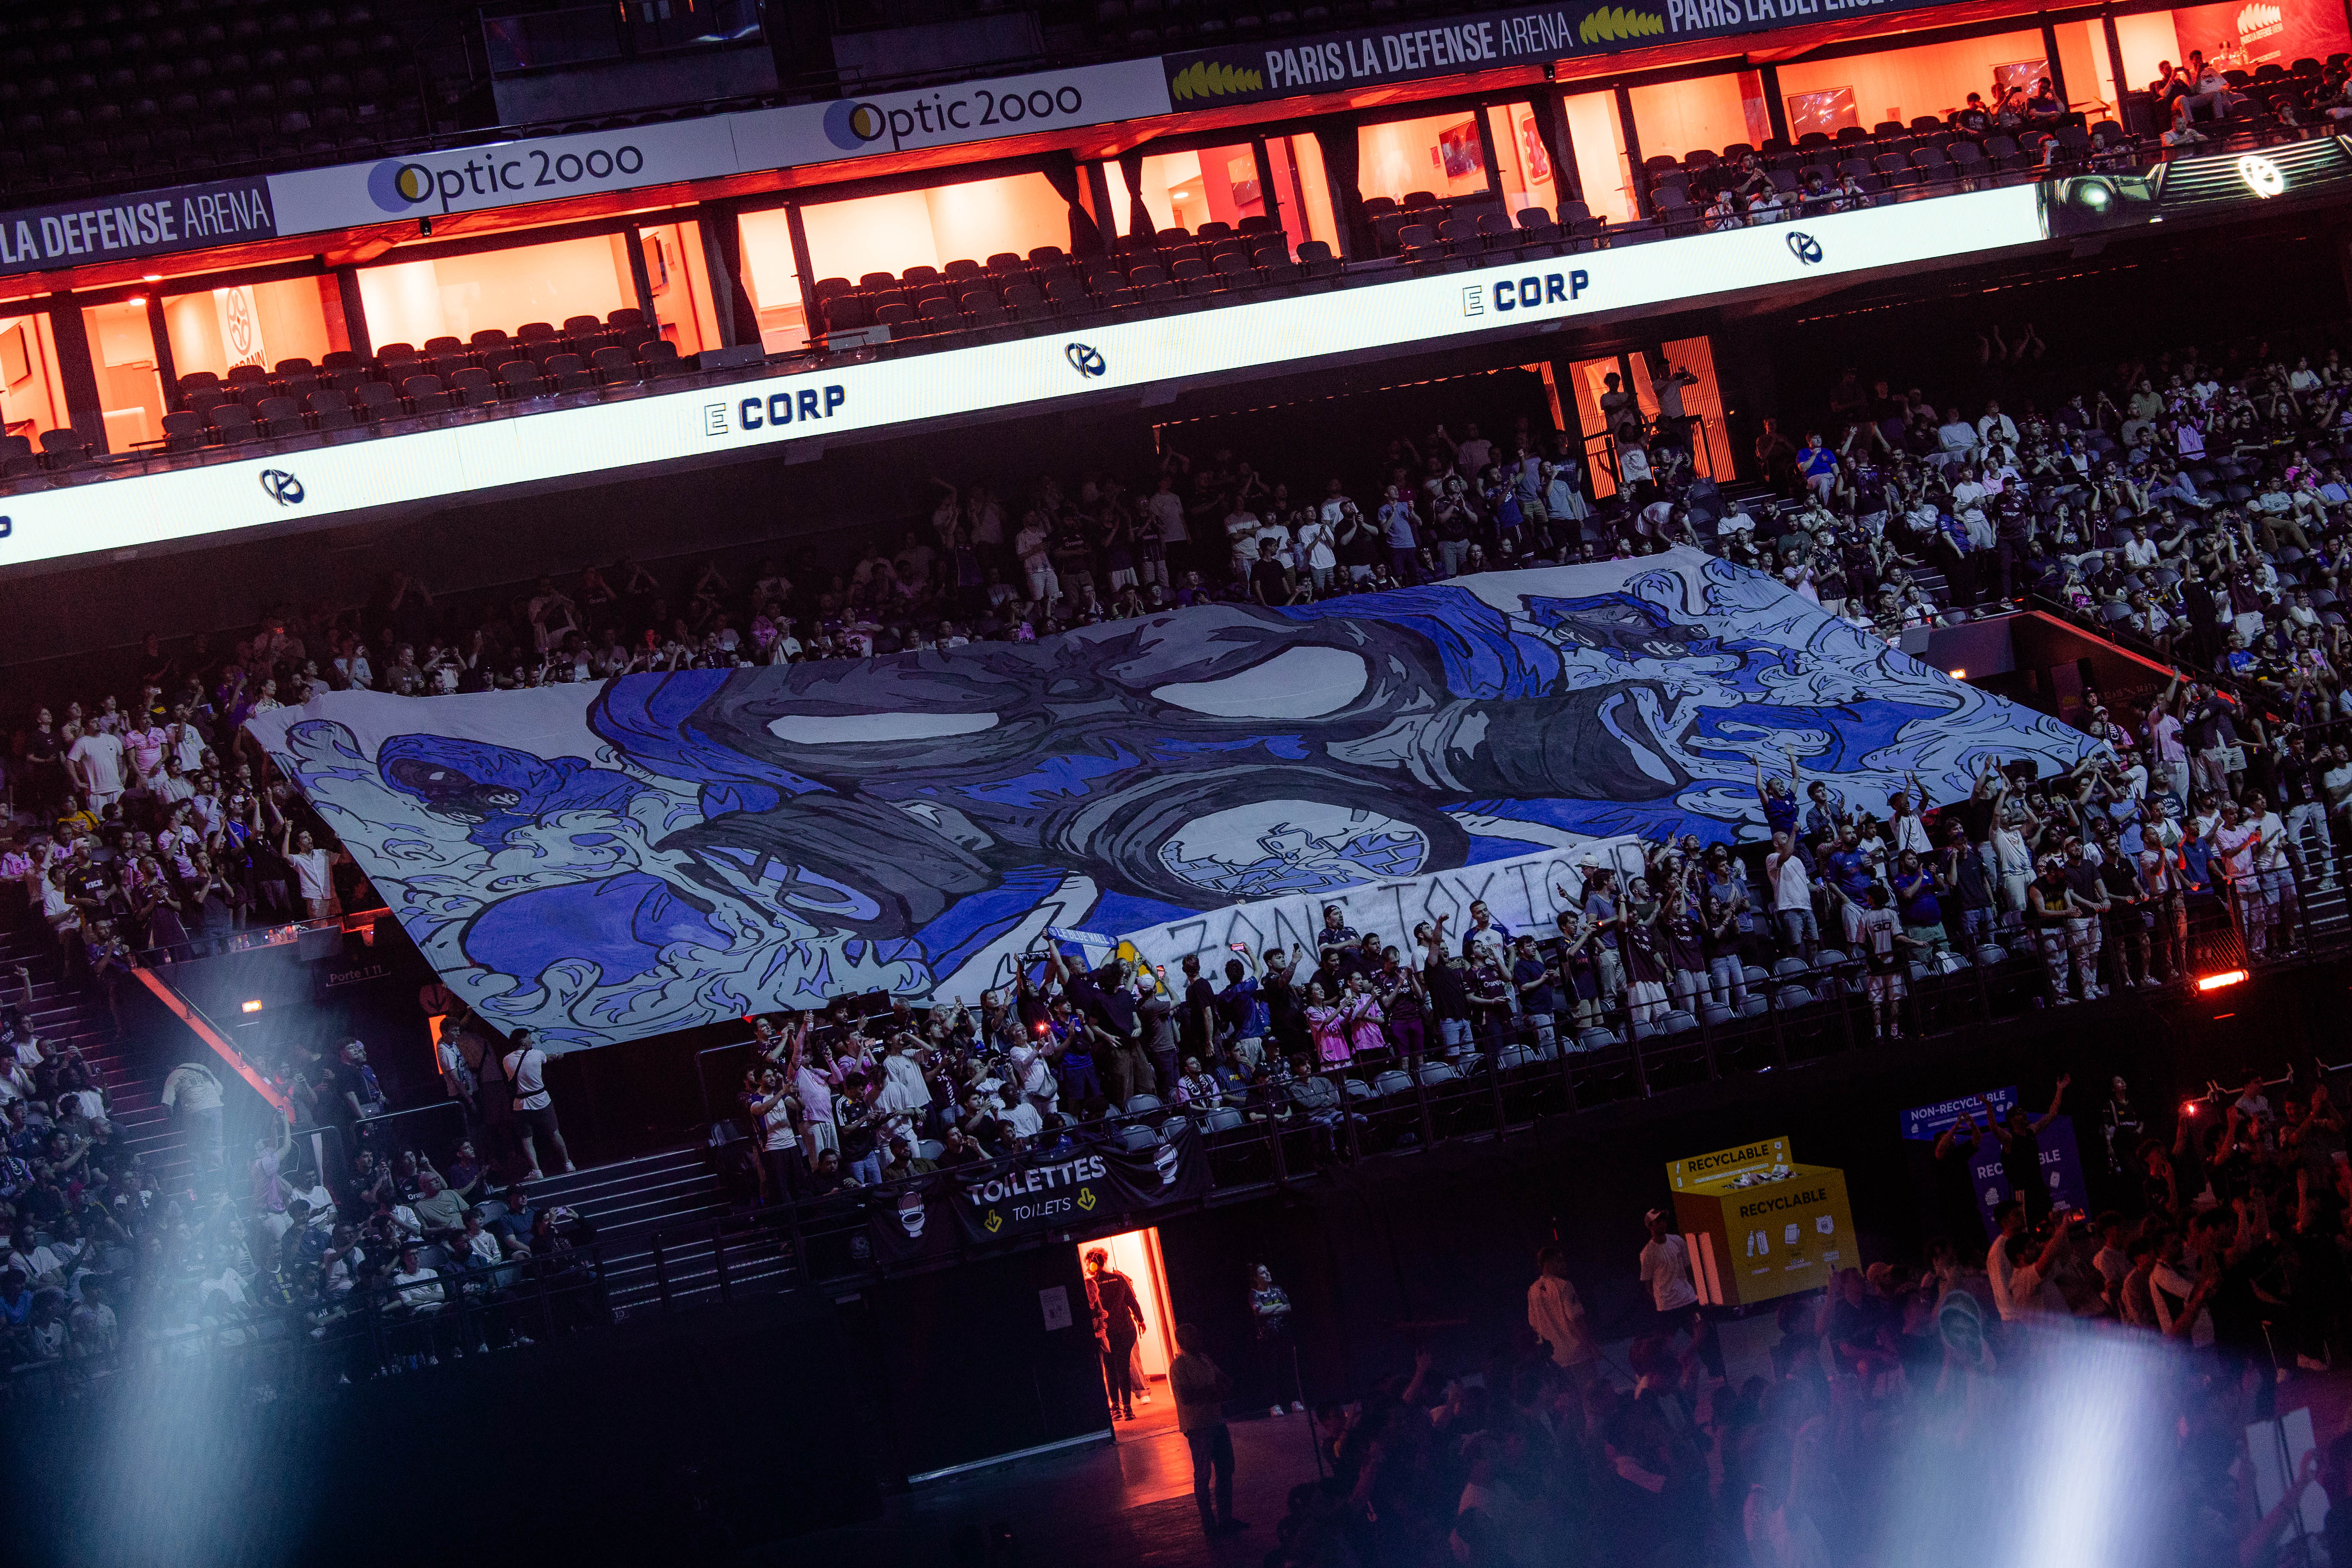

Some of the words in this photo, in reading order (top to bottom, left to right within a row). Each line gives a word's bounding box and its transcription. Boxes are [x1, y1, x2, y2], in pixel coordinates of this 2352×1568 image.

[1668, 0, 1741, 32] PARIS
[1266, 43, 1344, 88] PARIS
[1346, 38, 1381, 77] LA
[1383, 22, 1496, 72] DEFENSE
[1501, 12, 1573, 56] ARENA
[849, 93, 970, 151] Optic
[974, 86, 1082, 126] 2000
[395, 153, 524, 213] Optic
[529, 146, 644, 187] 2000
[0, 220, 40, 263] LA
[40, 201, 178, 257] DEFENSE
[184, 189, 271, 239] ARENA
[1493, 270, 1589, 311] CORP
[739, 385, 845, 430] CORP
[85, 879, 104, 890] KICK
[1055, 928, 1067, 938] LE
[1067, 930, 1088, 941] BLUE
[1087, 932, 1110, 944] WALL
[1873, 921, 1891, 933] 30
[330, 969, 361, 983] Porte
[1911, 1090, 2006, 1121] NON-RECYCLBLE
[1688, 1144, 1769, 1172] RECYCLABLE
[966, 1155, 1106, 1206] TOILETTES
[1012, 1197, 1071, 1221] TOILETS
[1740, 1188, 1827, 1218] RECYCLABLE
